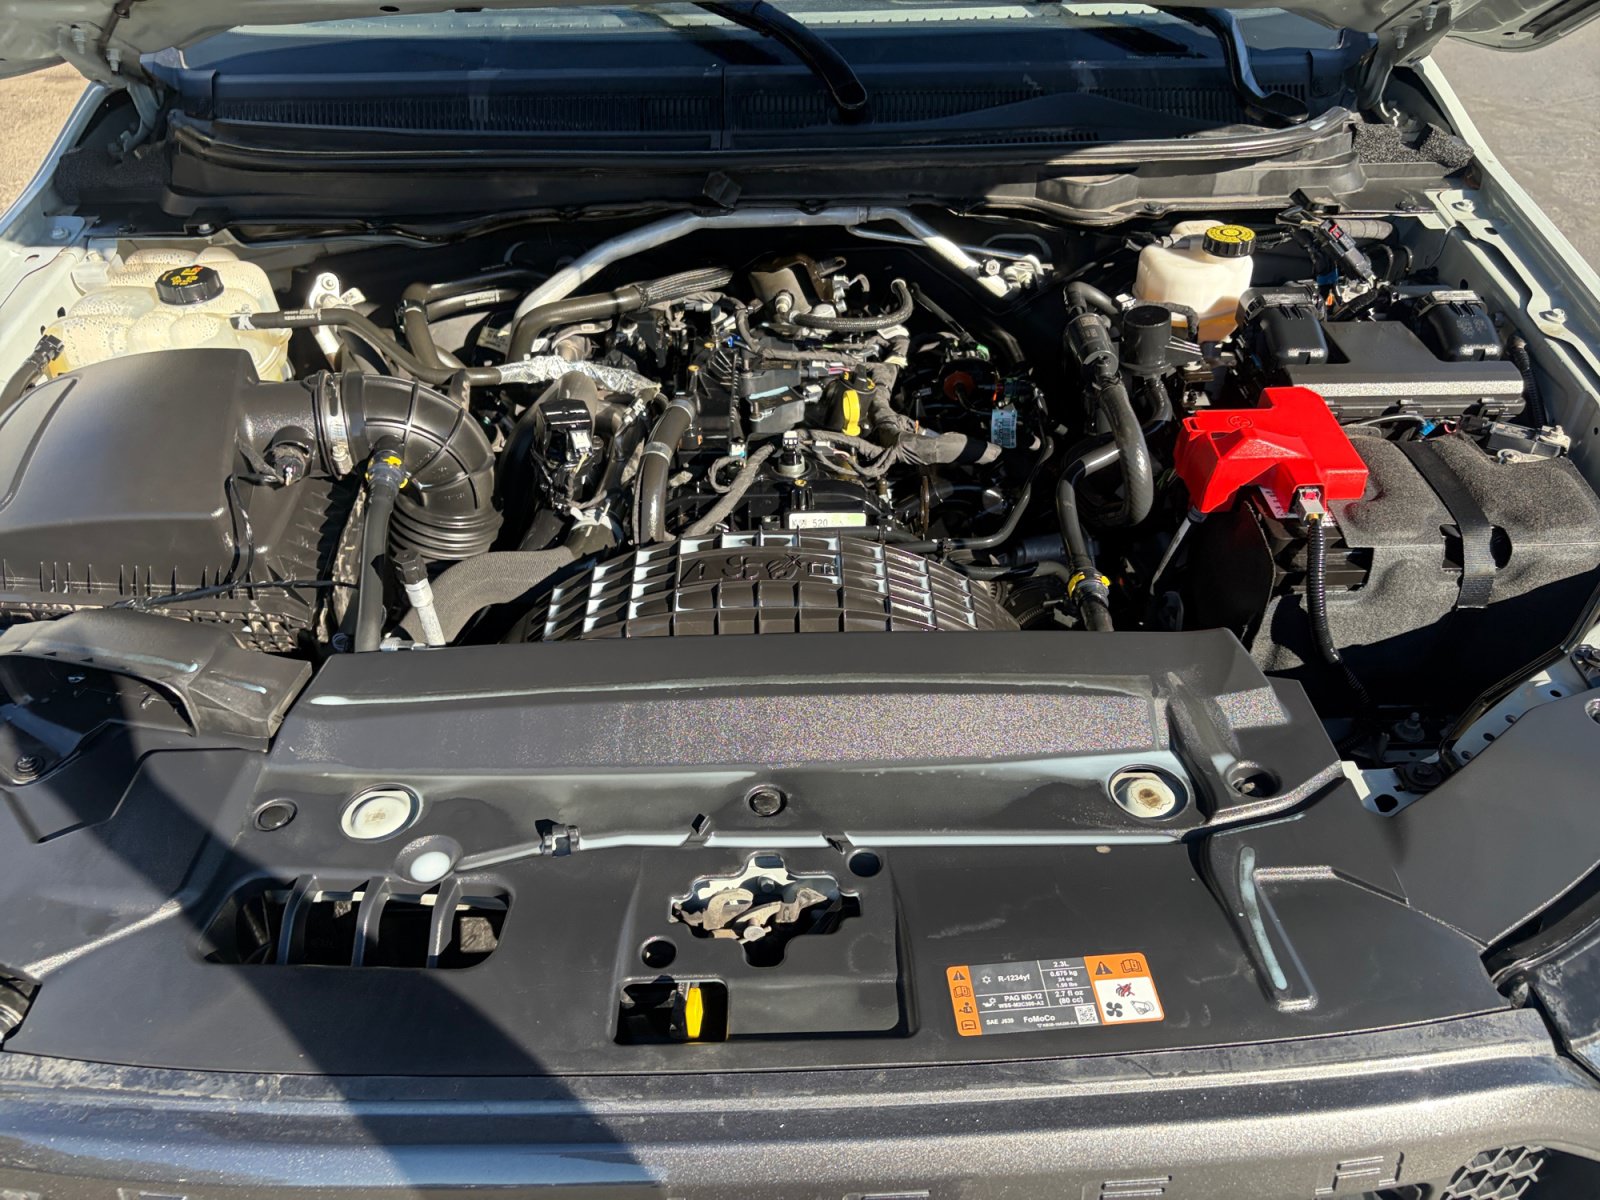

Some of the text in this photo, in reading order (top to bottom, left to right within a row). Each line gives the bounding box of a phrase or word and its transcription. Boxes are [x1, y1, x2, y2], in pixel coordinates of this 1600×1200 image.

[998, 974, 1030, 982] R-1234yf
[1059, 995, 1083, 1005] (80 cc)
[1023, 1015, 1056, 1023] FoMoCo
